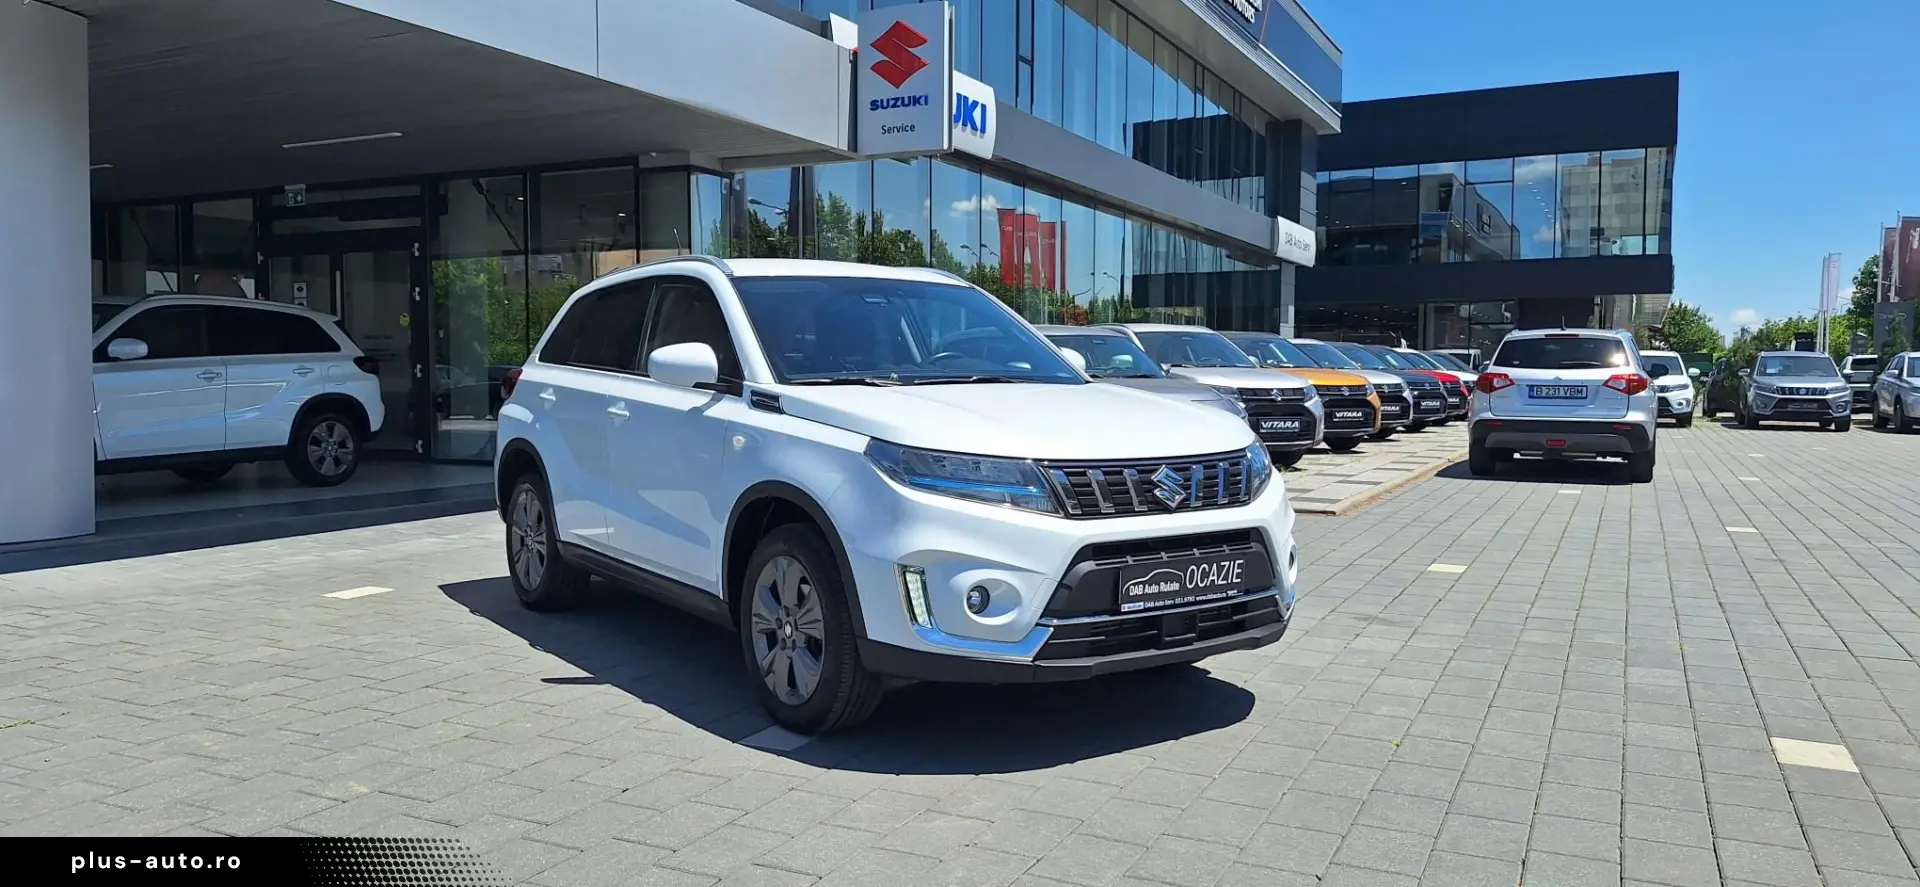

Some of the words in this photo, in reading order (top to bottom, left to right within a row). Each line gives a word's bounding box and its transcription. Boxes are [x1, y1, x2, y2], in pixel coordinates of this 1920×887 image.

[869, 94, 929, 112] SUZUKI
[881, 122, 916, 135] Service
[1535, 386, 1543, 395] B
[1545, 386, 1560, 396] 231
[1563, 386, 1583, 396] VBM
[1260, 421, 1299, 429] VITARA
[1186, 560, 1244, 589] OCAZIE
[1129, 585, 1143, 596] DAB
[1144, 583, 1159, 594] Auto
